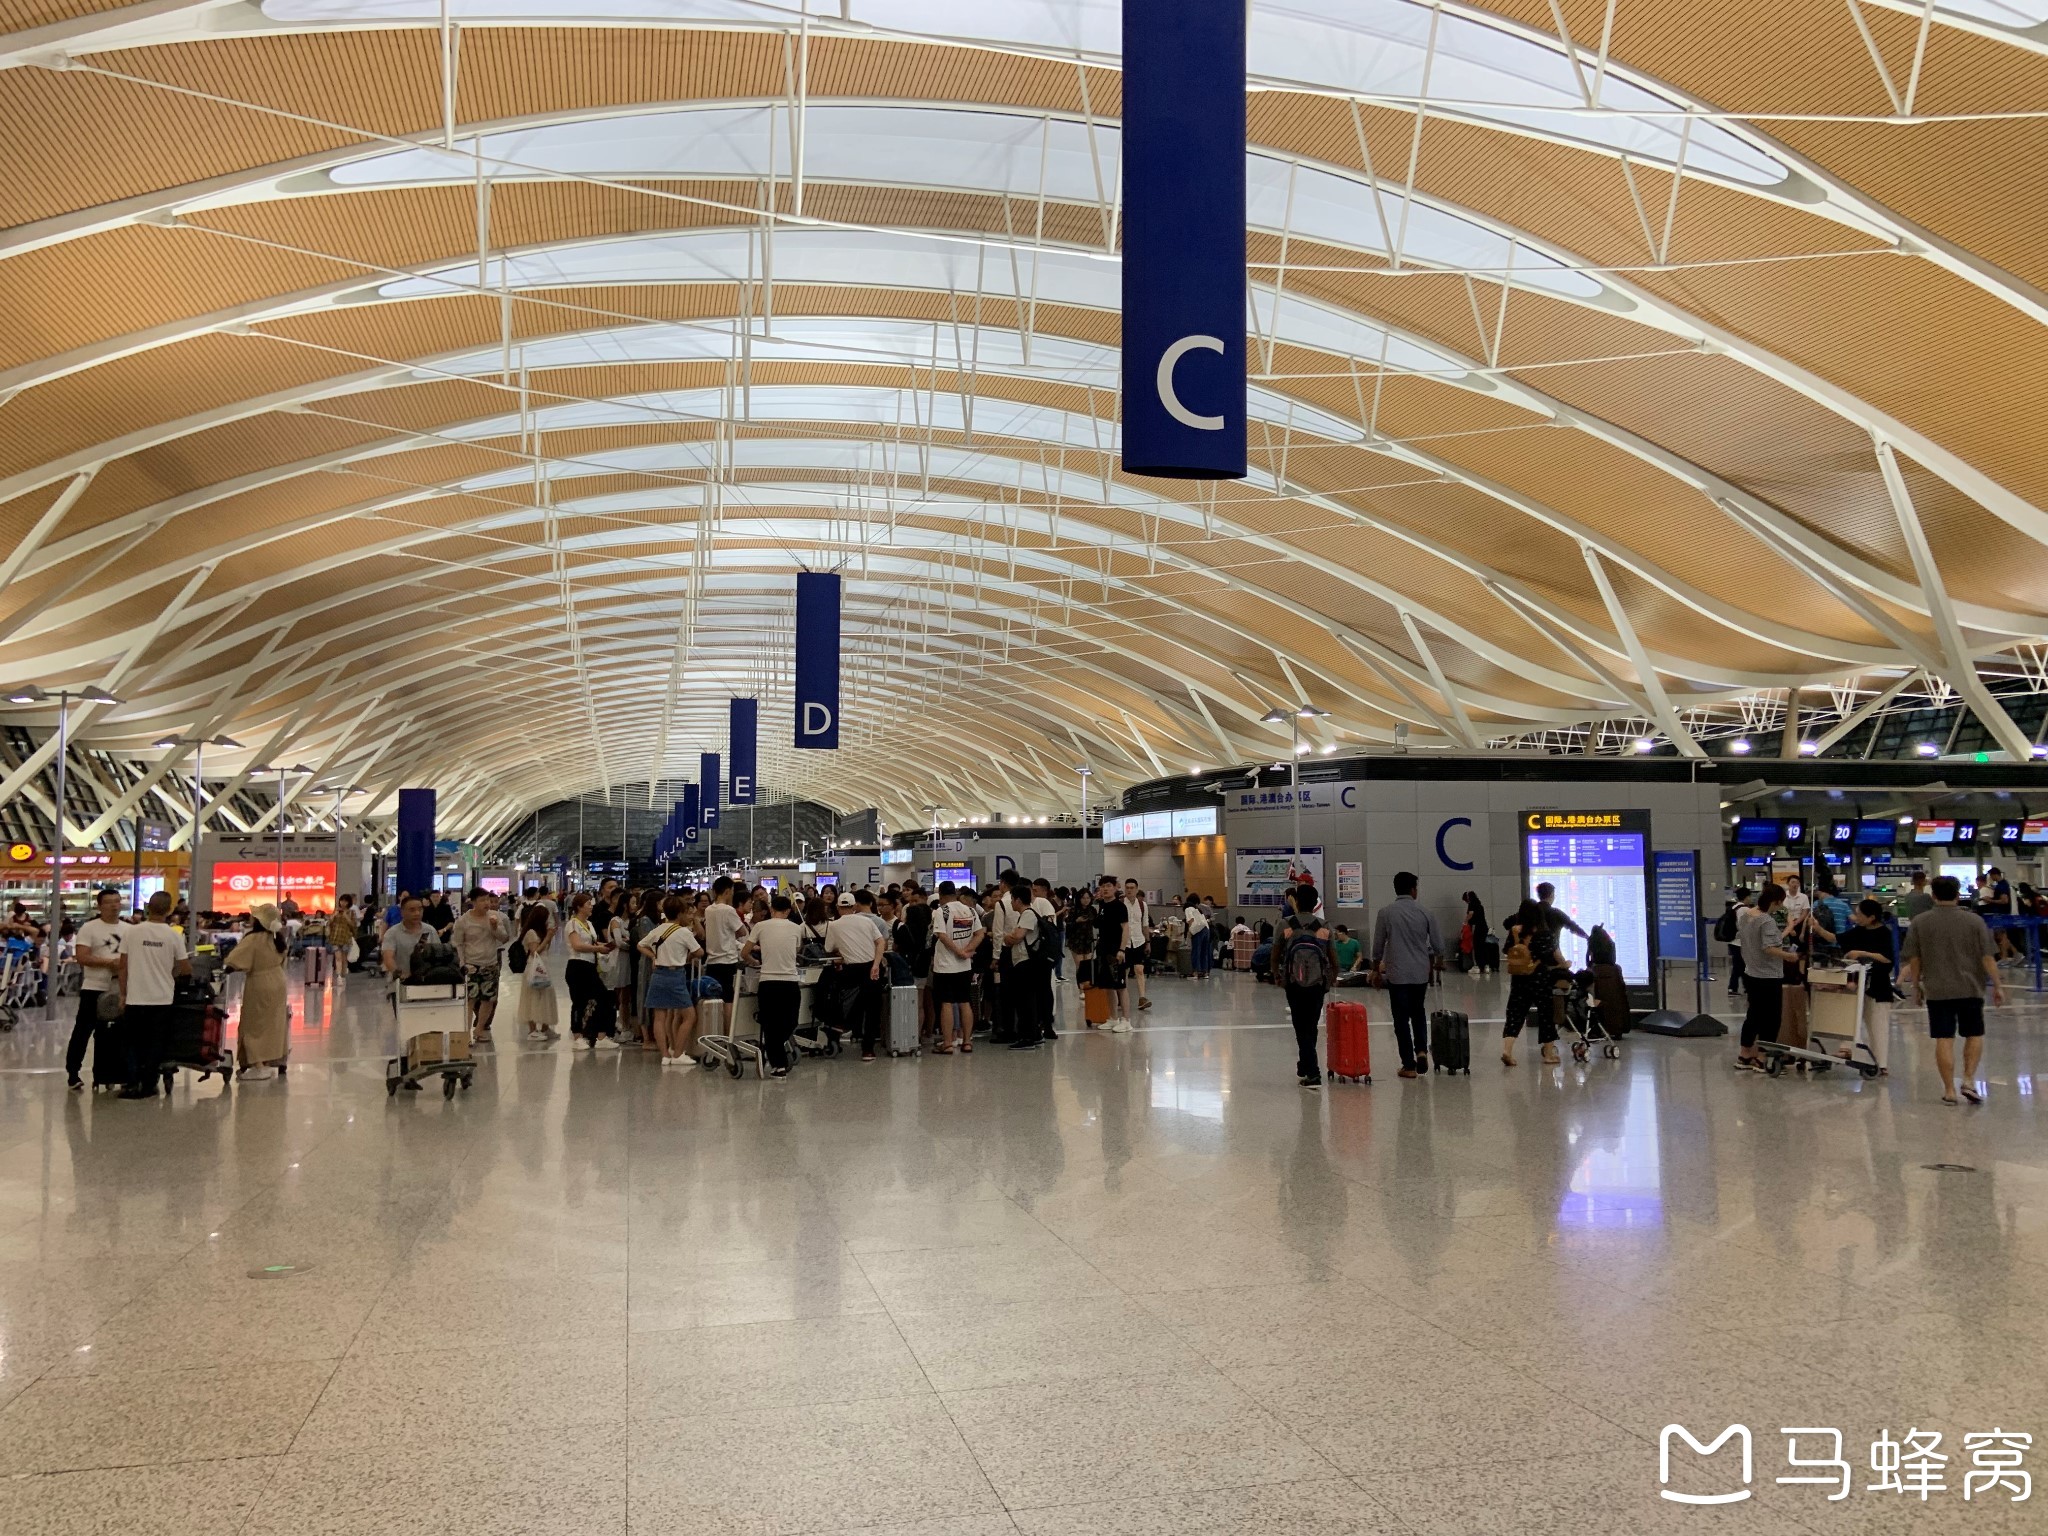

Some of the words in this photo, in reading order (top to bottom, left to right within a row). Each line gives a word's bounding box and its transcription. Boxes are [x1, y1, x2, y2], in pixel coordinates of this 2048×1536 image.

[1157, 334, 1225, 431] C
[803, 702, 832, 735] D
[735, 776, 751, 797] E
[1341, 786, 1356, 809] C
[704, 808, 716, 824] F
[1528, 814, 1541, 830] C
[685, 826, 696, 840] G
[1787, 827, 1801, 839] 19
[1834, 827, 1851, 840] 20
[1959, 827, 1974, 839] 21
[2003, 827, 2018, 839] 22
[676, 836, 685, 848] H
[956, 841, 963, 852] D
[1435, 817, 1475, 871] C
[868, 866, 881, 883] E
[996, 855, 1017, 881] D
